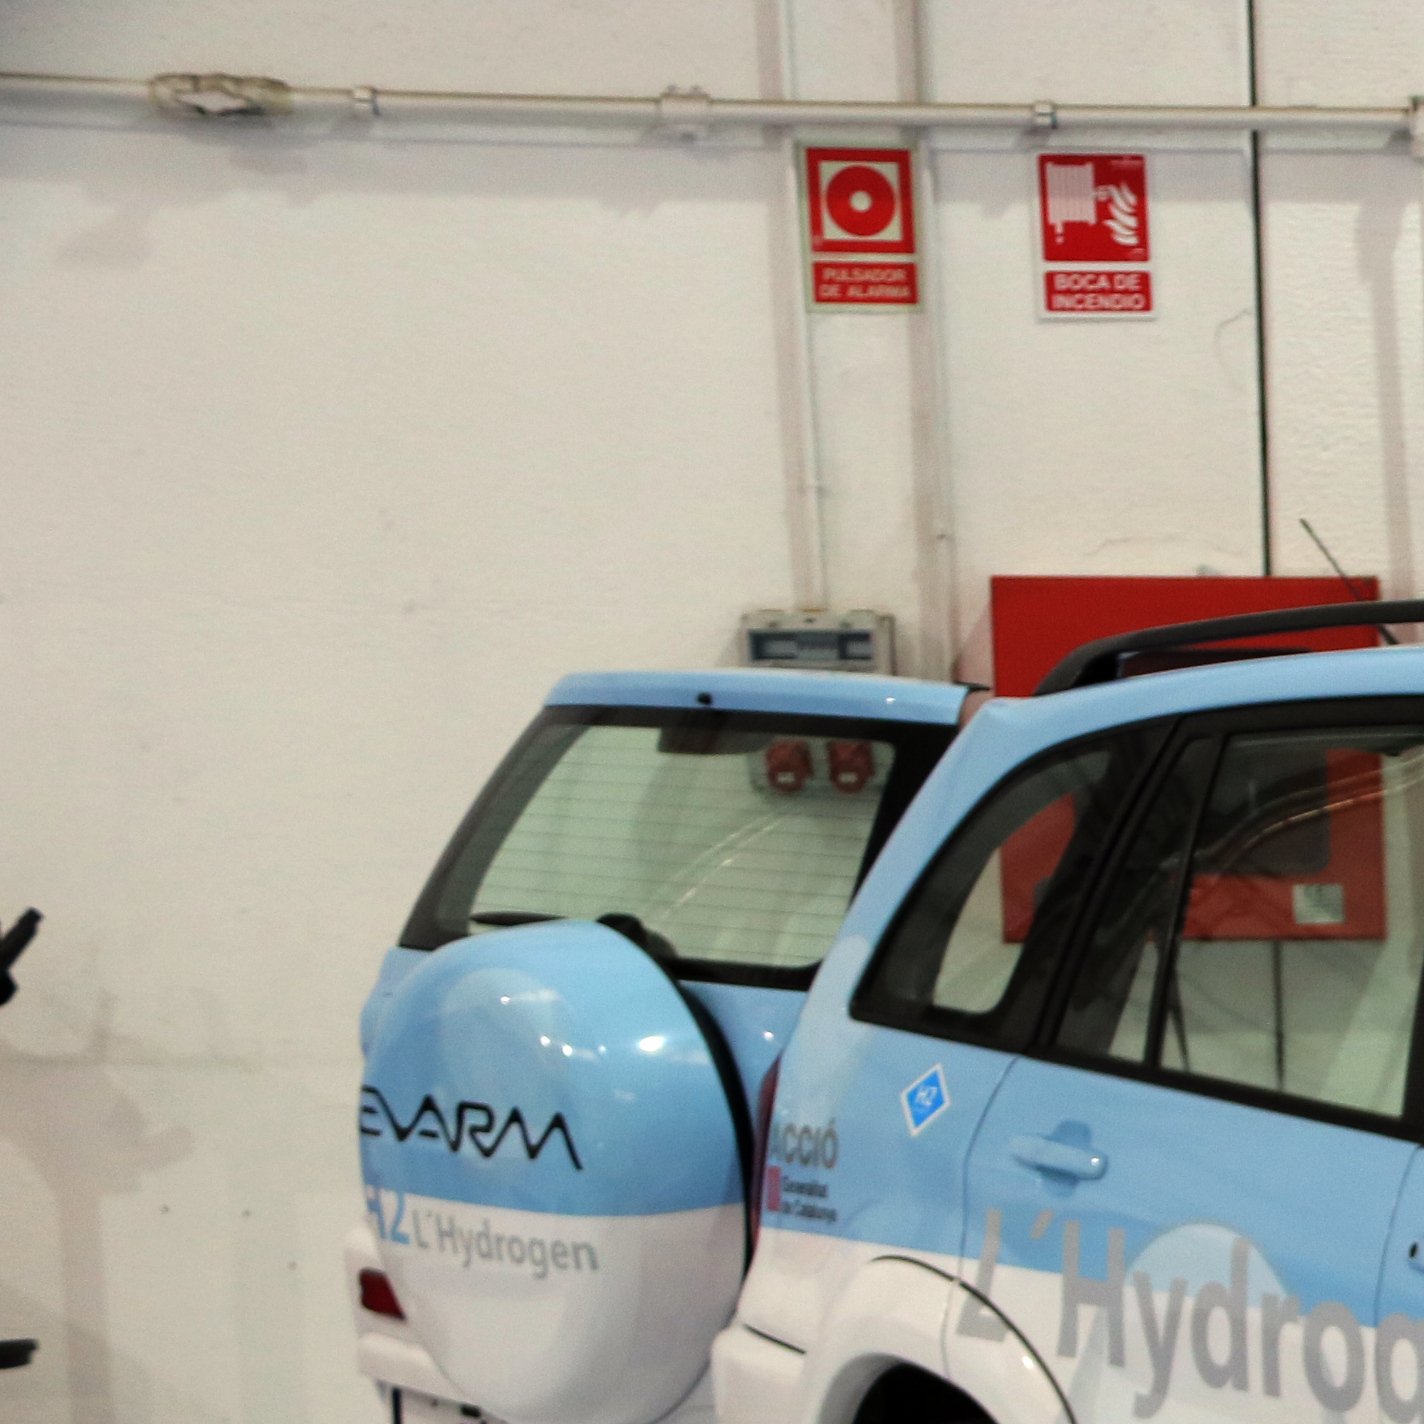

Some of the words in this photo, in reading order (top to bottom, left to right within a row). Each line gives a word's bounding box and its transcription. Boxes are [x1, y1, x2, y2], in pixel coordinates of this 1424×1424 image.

[823, 268, 907, 282] PULSADOR
[1053, 274, 1110, 289] BOCA
[1114, 274, 1141, 289] DE
[820, 284, 841, 297] DE
[847, 285, 910, 297] ALARMA
[1051, 294, 1144, 310] INCENDIO
